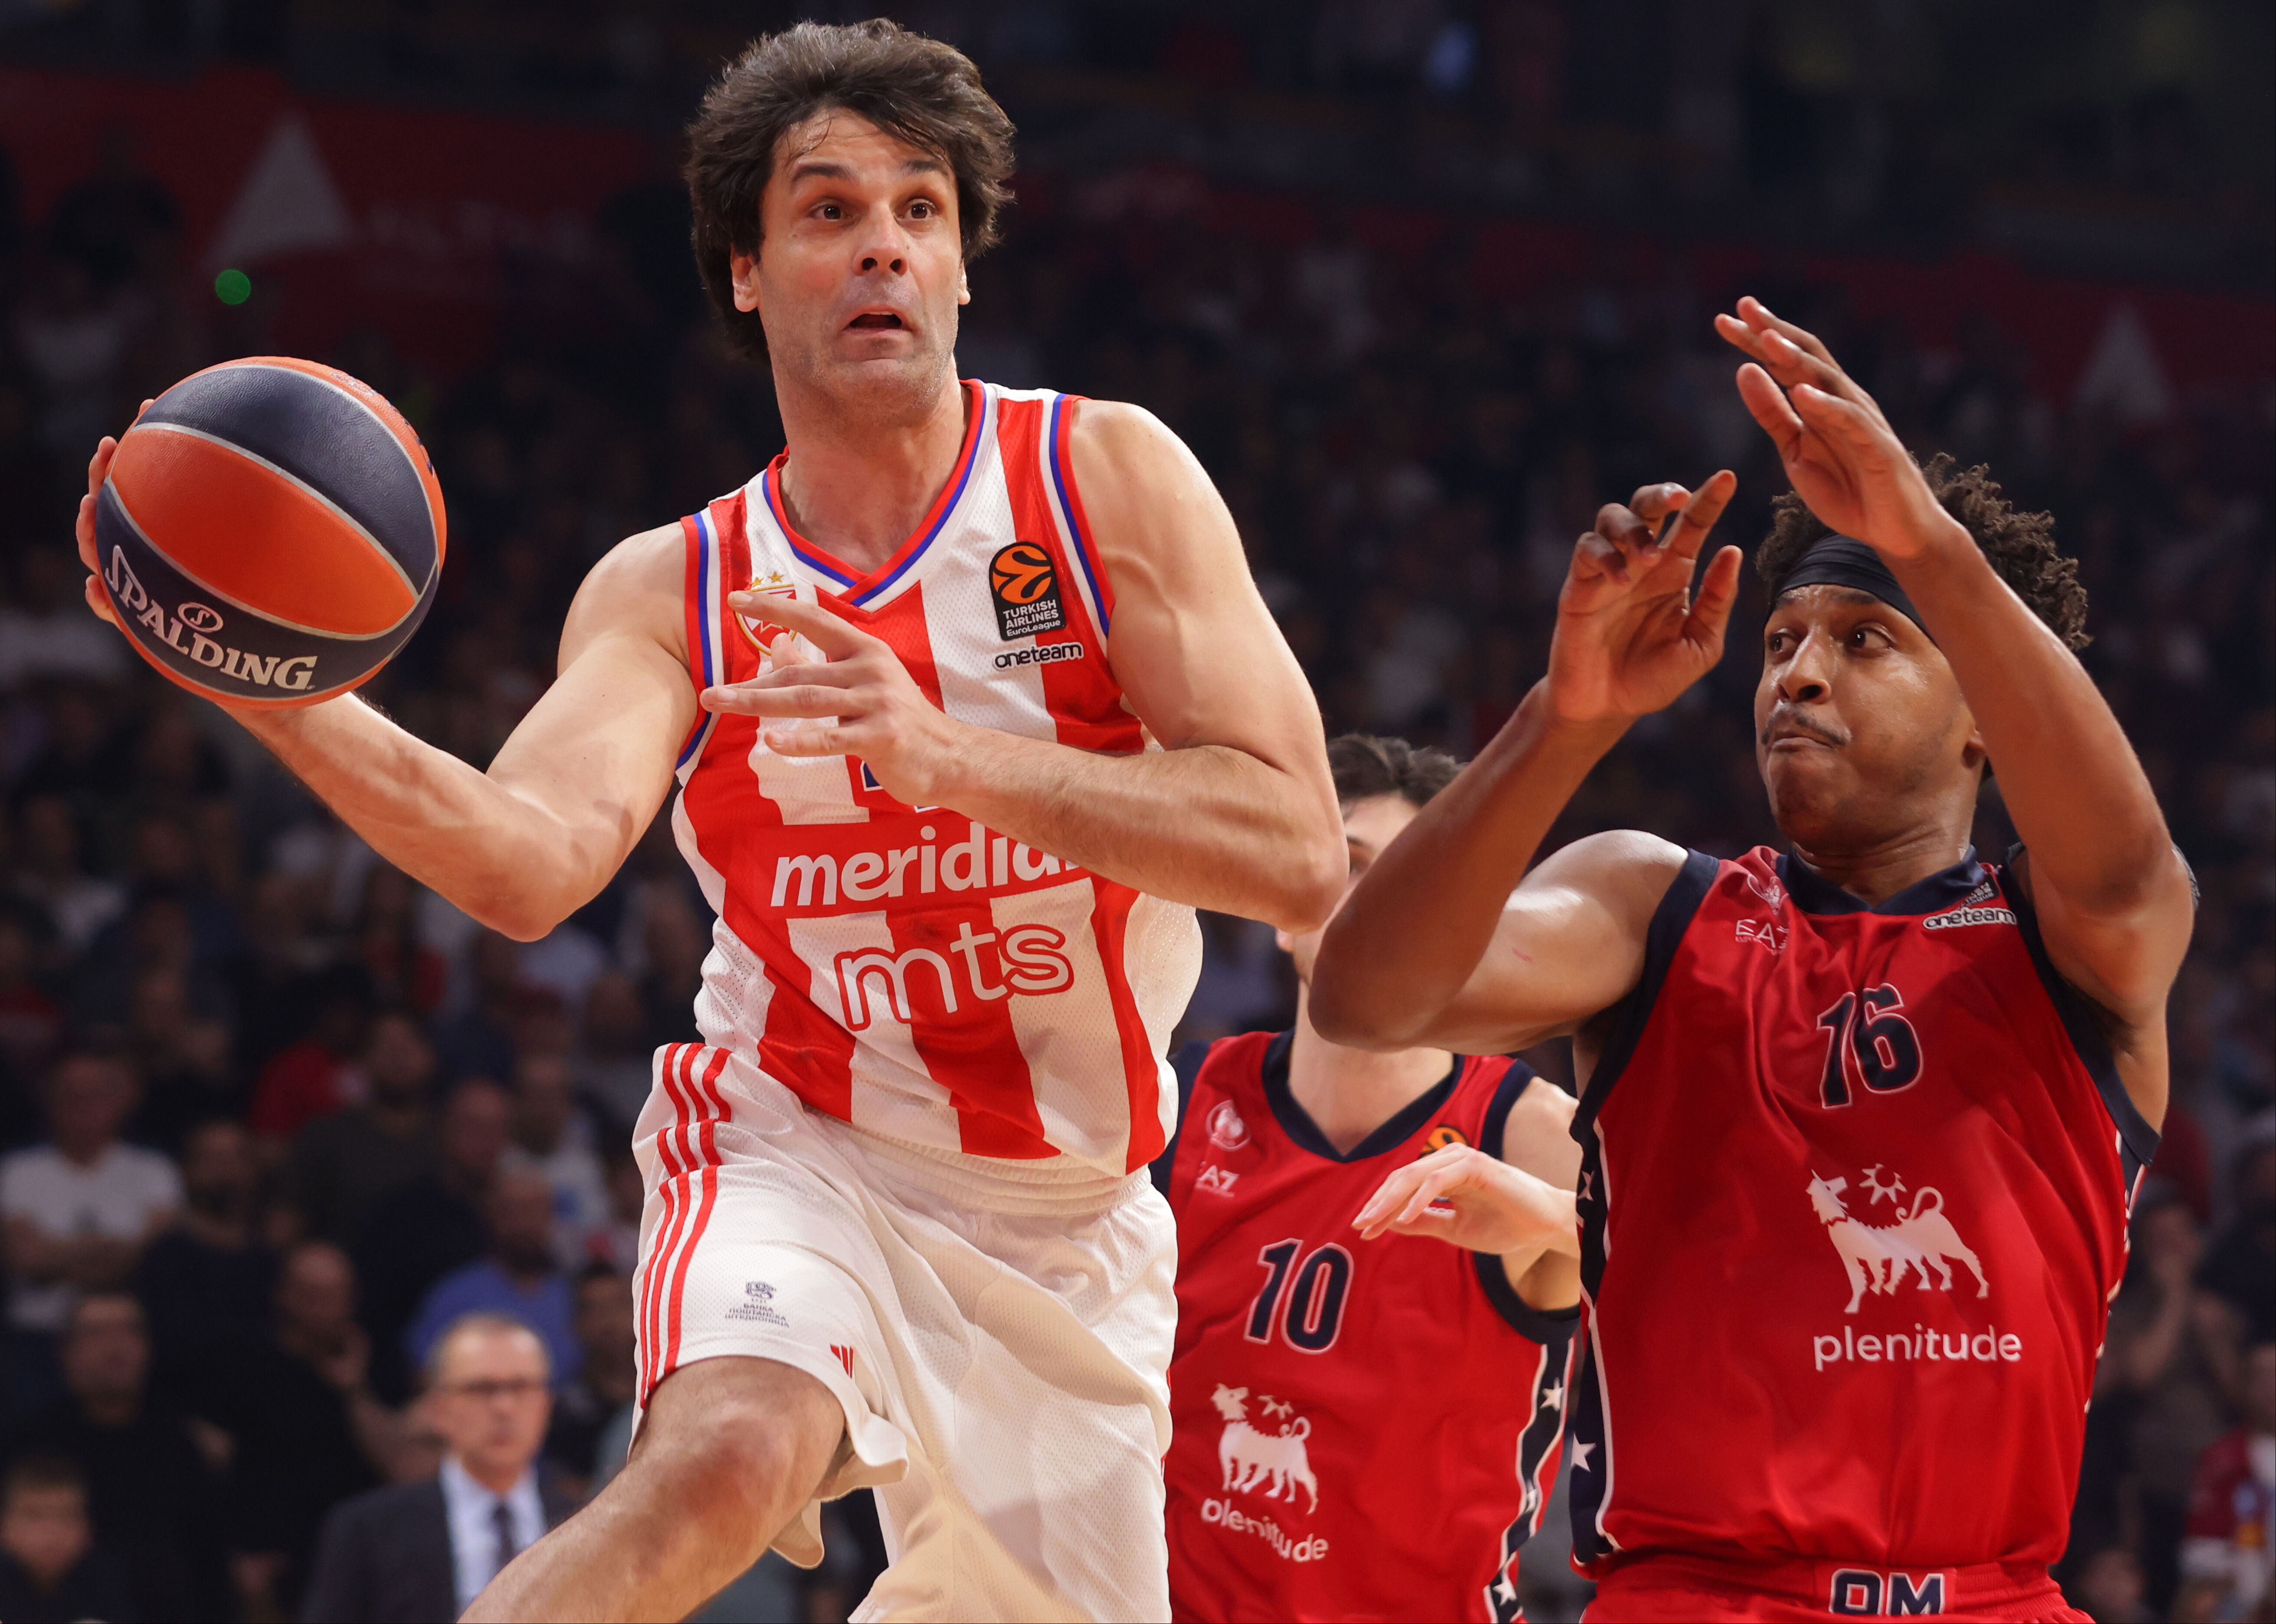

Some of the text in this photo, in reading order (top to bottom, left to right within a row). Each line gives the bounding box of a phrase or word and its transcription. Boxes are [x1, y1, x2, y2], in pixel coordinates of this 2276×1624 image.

[105, 545, 318, 690] SPALDING
[1003, 599, 1057, 619] TURKISH
[1006, 609, 1059, 629] AIRLINES
[1006, 619, 1061, 637] EuroLeague
[995, 644, 1082, 668] oneteam
[770, 821, 1080, 907] meridia
[1925, 908, 2016, 928] oneteam
[840, 921, 1070, 1025] mts
[1816, 982, 1924, 1109] 16
[729, 1308, 786, 1321] ПОШТАНСКА
[744, 1303, 774, 1312] БАНКА
[1243, 1238, 1354, 1355] 10
[1813, 1323, 2023, 1372] plenitude
[1828, 1568, 1945, 1616] OM
